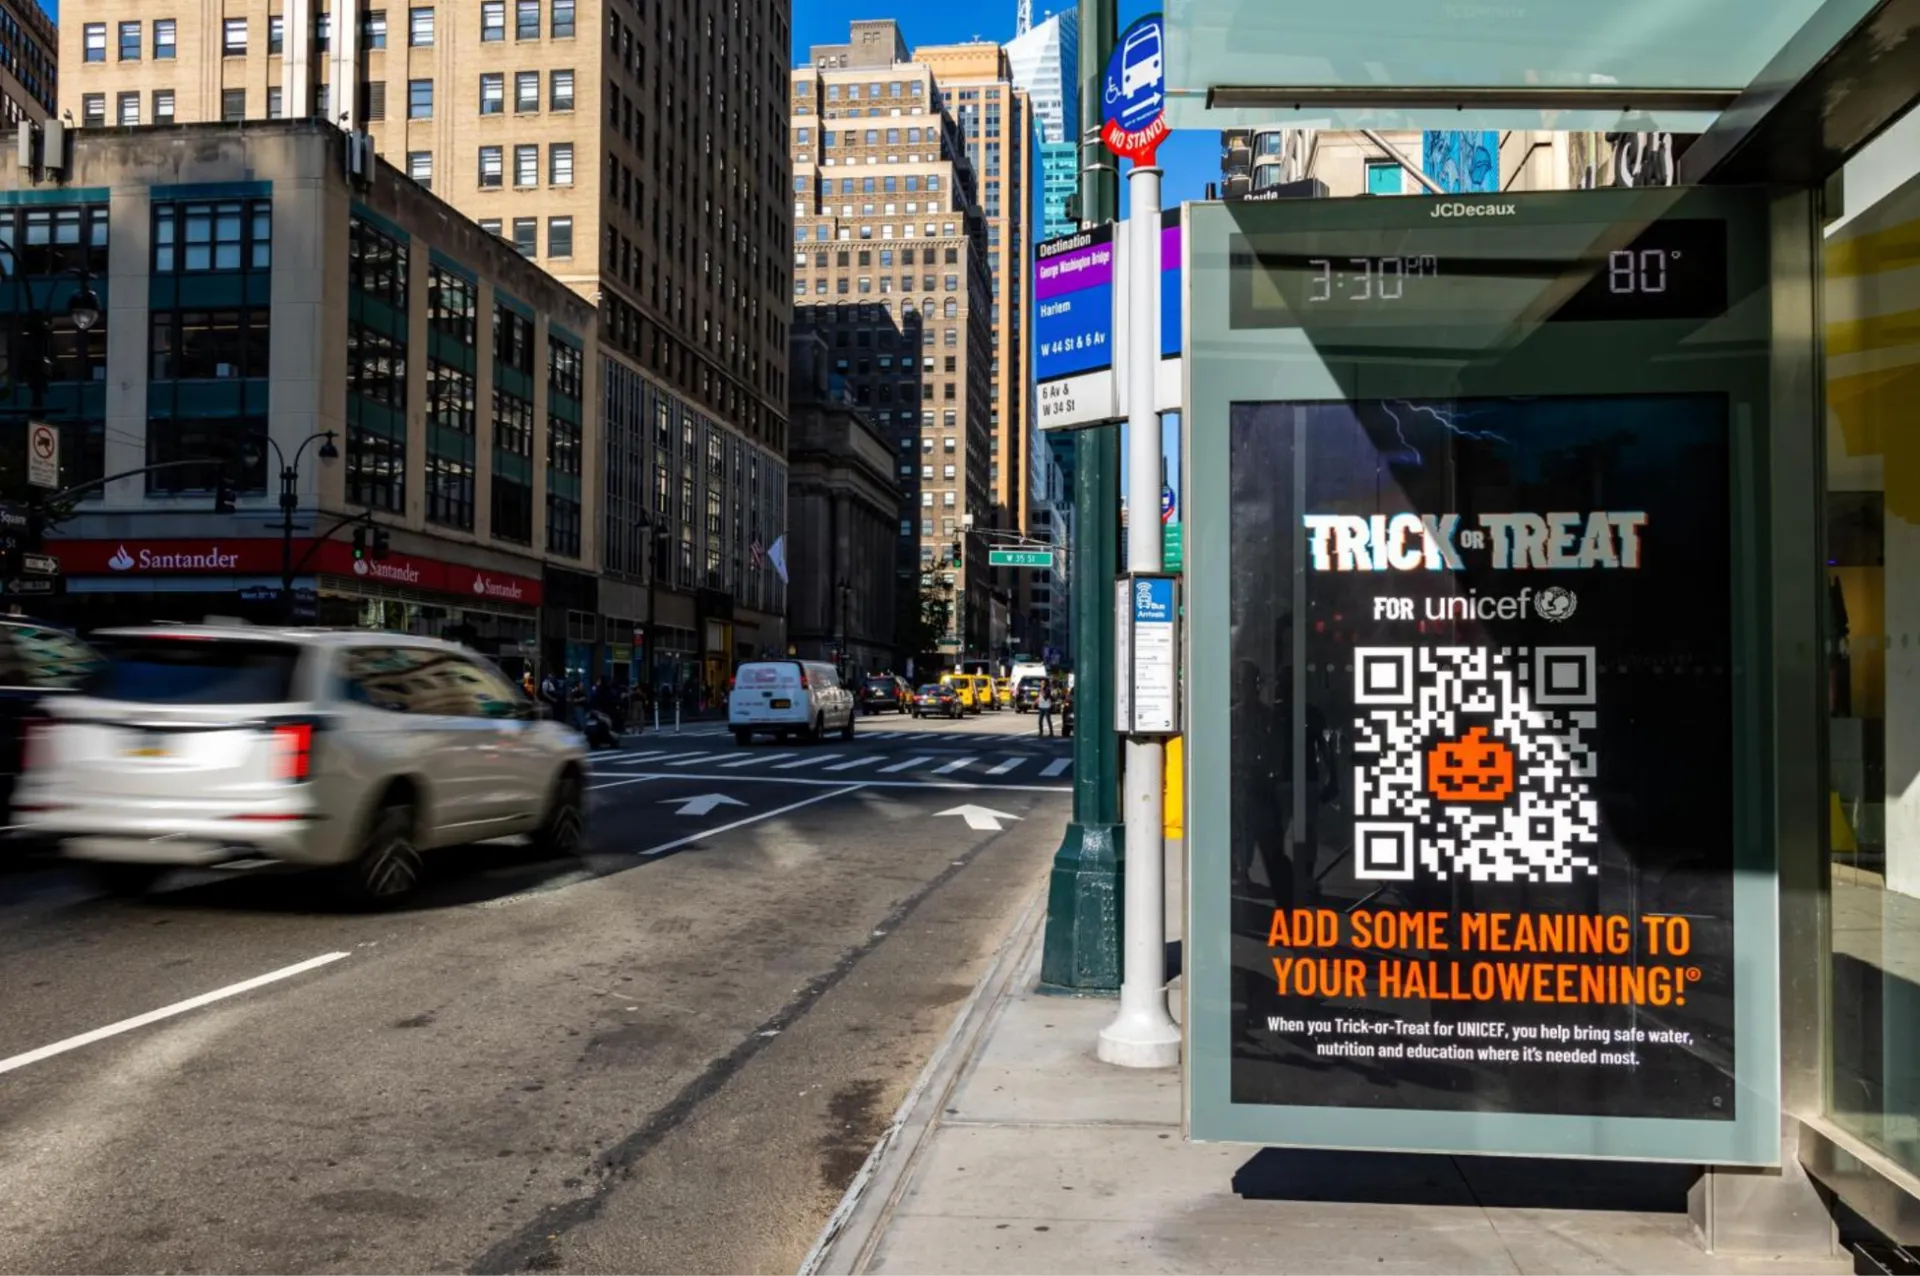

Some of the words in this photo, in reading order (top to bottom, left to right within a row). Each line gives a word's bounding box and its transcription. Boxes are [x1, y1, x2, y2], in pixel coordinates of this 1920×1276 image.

[1109, 127, 1126, 148] NO
[1431, 203, 1516, 217] JCDecaux
[1040, 233, 1091, 258] Destination
[1308, 257, 1402, 301] 3:30
[1040, 301, 1071, 317] Harlem
[1041, 343, 1050, 356] W
[1052, 340, 1062, 354] 44
[1065, 337, 1074, 352] St
[1076, 335, 1083, 350] &
[1085, 333, 1092, 347] 6
[1094, 331, 1106, 345] Av
[1042, 387, 1048, 400] 6
[1050, 385, 1060, 398] Av
[1063, 383, 1069, 396] &
[1042, 404, 1051, 416] W
[1053, 402, 1063, 414] 34
[1066, 399, 1075, 412] St
[1303, 512, 1464, 571] TRICK
[1460, 529, 1484, 551] OR
[1478, 511, 1648, 570] TREAT
[139, 547, 239, 569] Santander
[369, 559, 419, 583] Santander
[485, 578, 523, 599] Santander
[1373, 595, 1415, 621] FOR
[1425, 587, 1532, 621] unicef
[1268, 909, 1338, 949] ADD
[1351, 910, 1448, 950] SOME
[1462, 913, 1630, 955] MEANING
[1643, 915, 1691, 956] TO
[1272, 957, 1367, 997] YOUR
[1268, 1017, 1304, 1032] When
[1307, 1021, 1331, 1035] you
[1334, 1018, 1430, 1036] Trick-or-Treat
[1433, 1021, 1454, 1036] for
[1457, 1022, 1509, 1039] UNICEF,
[1512, 1025, 1537, 1041] you
[1540, 1024, 1570, 1043] help
[1574, 1025, 1610, 1044] bring
[1614, 1027, 1645, 1042] safe
[1648, 1029, 1693, 1046] water,
[1317, 1040, 1375, 1057] nutrition
[1378, 1043, 1403, 1058] and
[1406, 1044, 1474, 1060] education
[1477, 1046, 1519, 1062] where
[1523, 1046, 1543, 1062] it's
[1546, 1049, 1597, 1064] needed
[1600, 1051, 1640, 1066] most.
